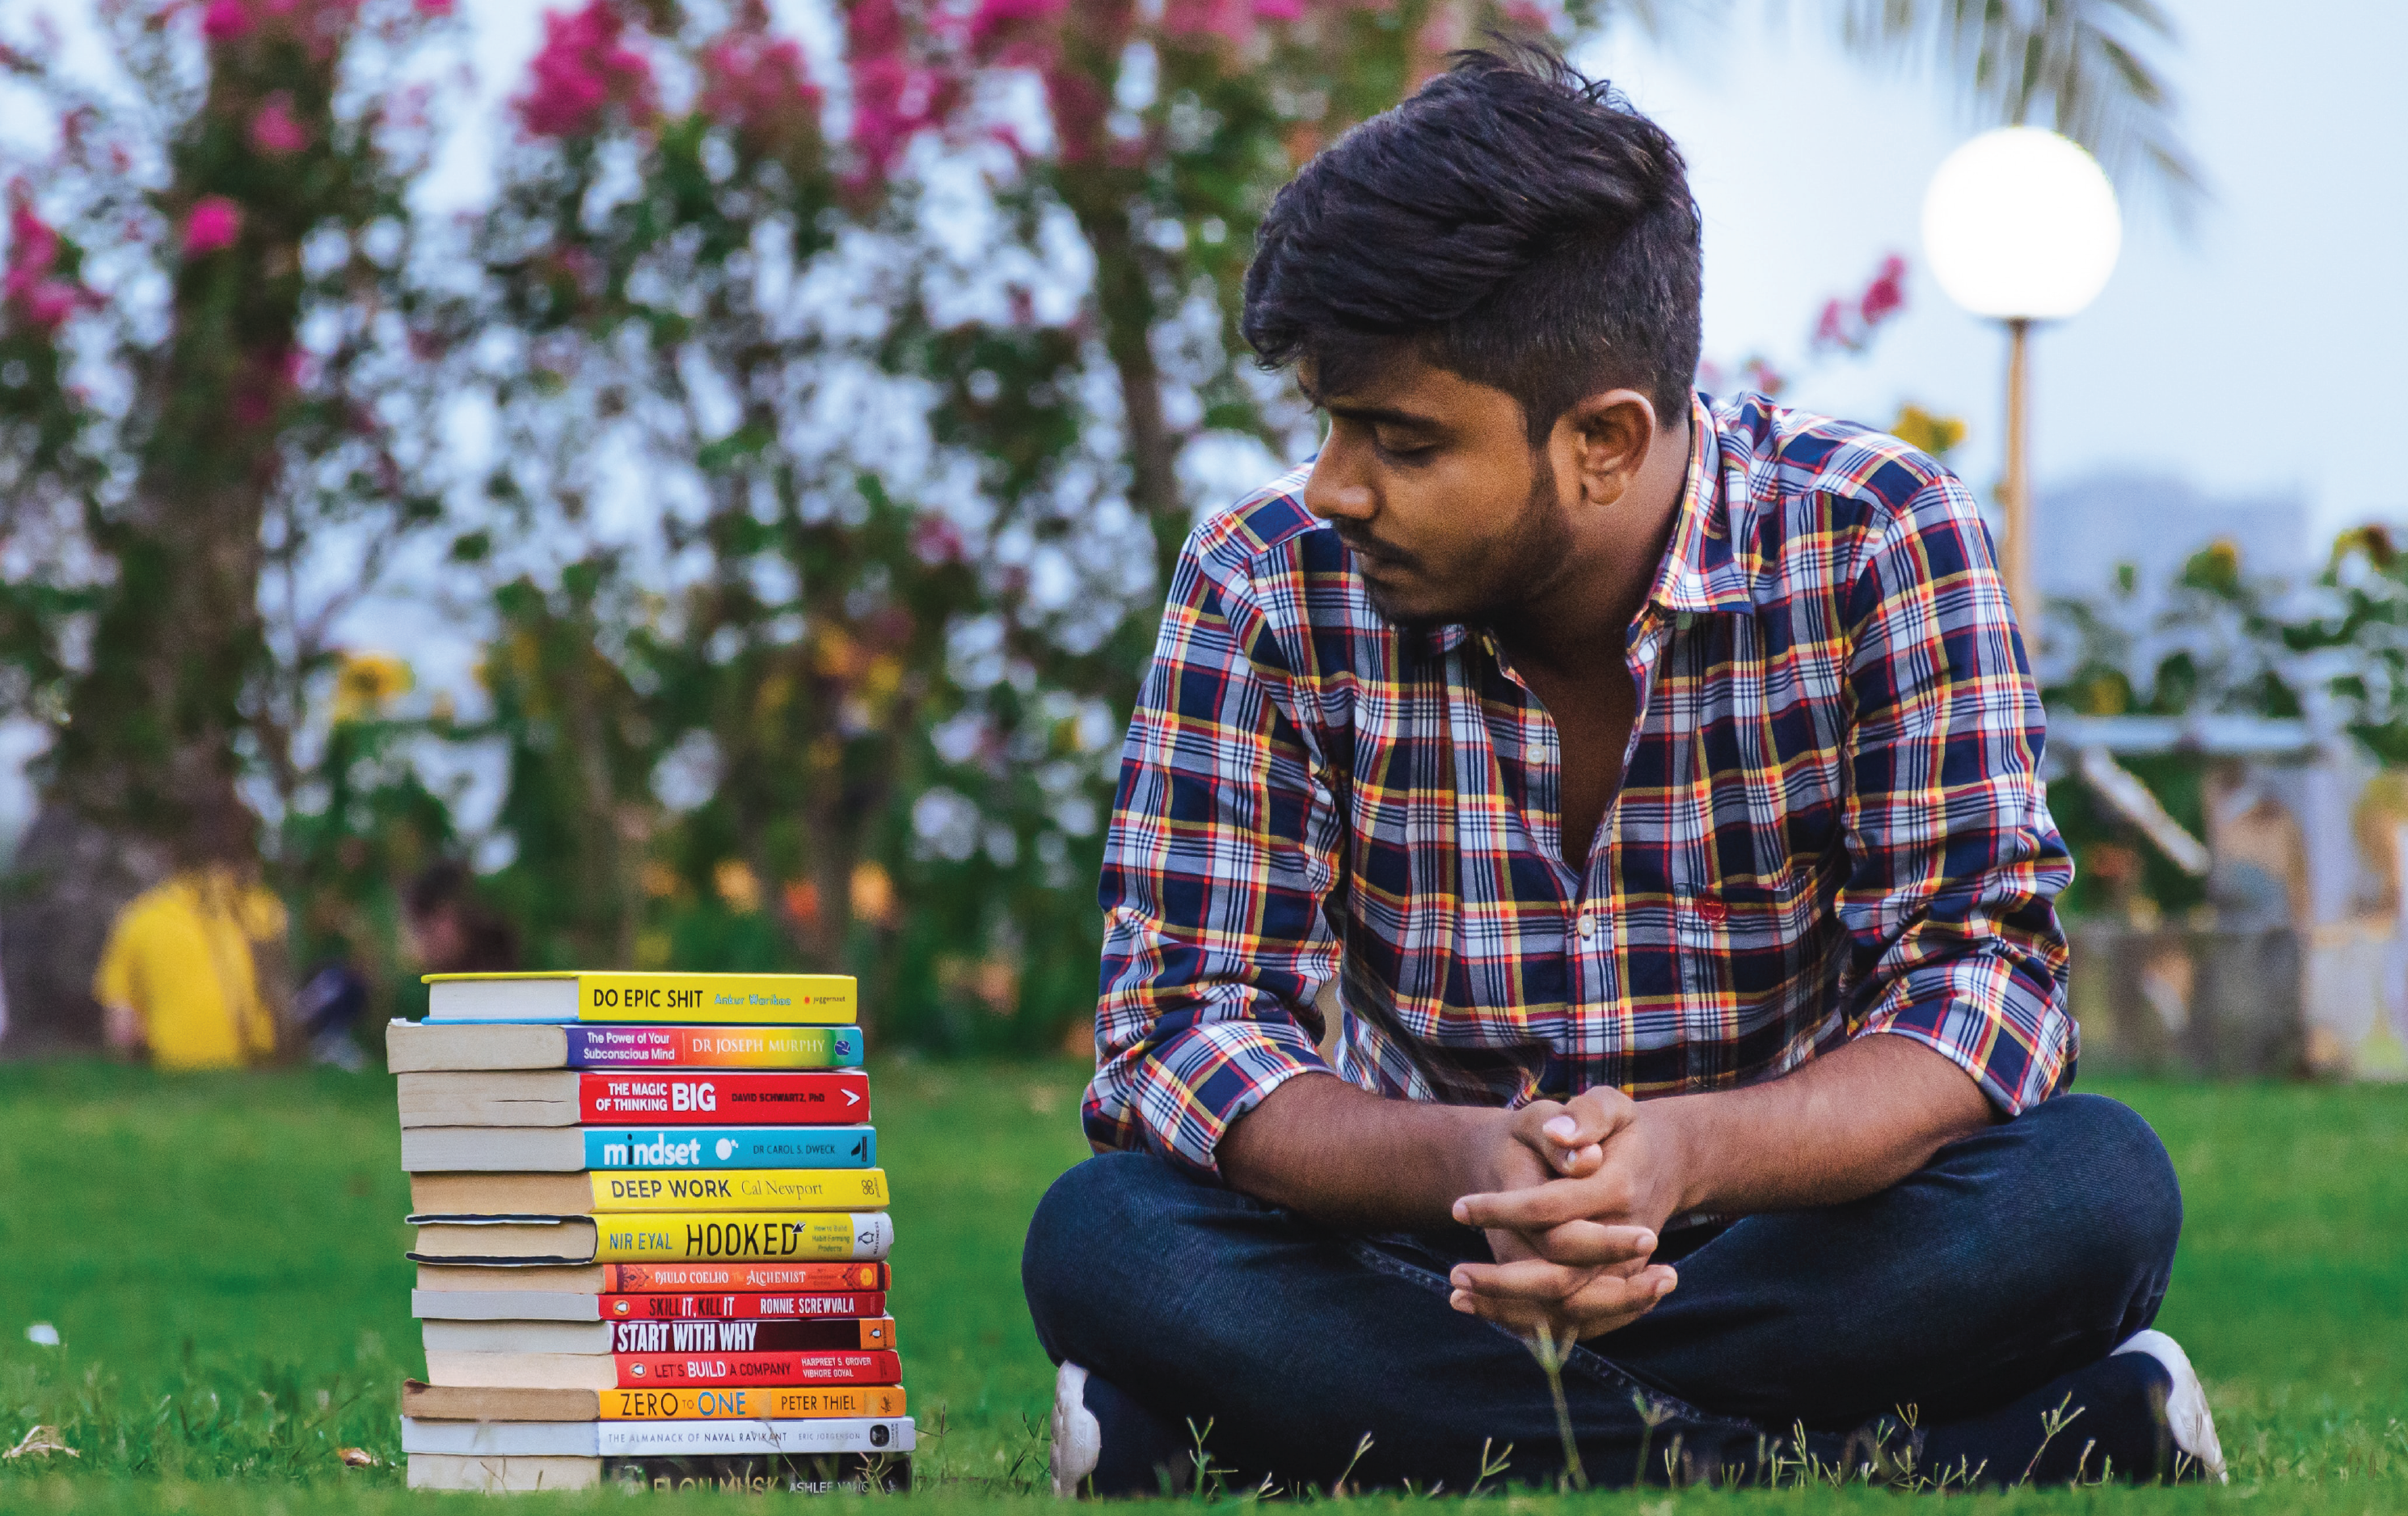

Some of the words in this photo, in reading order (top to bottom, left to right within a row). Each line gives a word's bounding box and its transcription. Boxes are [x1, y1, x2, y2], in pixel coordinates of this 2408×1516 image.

[594, 989, 618, 1007] DO
[625, 989, 661, 1007] EPIC
[668, 989, 703, 1008] SHIT
[715, 994, 744, 1005] Ankur
[749, 994, 791, 1006] Warikoo
[813, 995, 846, 1006] juggernaut
[588, 1032, 604, 1044] The
[606, 1032, 635, 1044] Power
[637, 1032, 647, 1044] of
[648, 1032, 669, 1045] Your
[584, 1047, 649, 1060] Subconscious
[651, 1048, 675, 1061] Mind
[693, 1039, 712, 1052] DR
[716, 1039, 764, 1054] JOSEPH
[769, 1039, 825, 1053] MURPHY
[608, 1083, 630, 1096] THE
[632, 1083, 668, 1096] MAGIC
[671, 1082, 716, 1112] BIG
[596, 1098, 612, 1111] OF
[614, 1098, 668, 1112] THINKING
[732, 1093, 757, 1102] DAVID
[759, 1093, 807, 1104] SCHWARTZ,
[809, 1093, 825, 1103] PhD
[604, 1133, 701, 1166] mindset
[753, 1145, 764, 1155] DR
[766, 1145, 795, 1155] CAROL
[797, 1145, 803, 1155] S.
[806, 1145, 835, 1155] DWECK
[611, 1180, 662, 1199] DEEP
[668, 1179, 732, 1199] WORK
[741, 1180, 762, 1197] Cal
[765, 1180, 824, 1201] Newport
[609, 1232, 633, 1251] NIR
[639, 1232, 673, 1251] EYAL
[685, 1223, 797, 1257] HOOKED
[655, 1271, 686, 1286] PAULO
[690, 1271, 729, 1284] COELHO
[746, 1269, 806, 1286] ALCHEMIST
[649, 1299, 681, 1316] SKILL
[698, 1298, 721, 1316] KILL
[723, 1296, 735, 1316] IT
[760, 1298, 795, 1315] RONNIE
[799, 1297, 855, 1314] SCREWVALA
[617, 1323, 669, 1353] START
[673, 1322, 715, 1352] WITH
[719, 1322, 757, 1352] WHY
[801, 1357, 836, 1366] HARPREET
[845, 1357, 872, 1366] GROVER
[654, 1364, 685, 1379] LET'S
[687, 1361, 726, 1379] BUILD
[729, 1364, 737, 1376] A
[739, 1362, 791, 1376] COMPANY
[803, 1369, 832, 1379] VIBHORE
[833, 1369, 854, 1378] GOYAL
[620, 1391, 678, 1417] ZERO
[682, 1399, 694, 1410] TO
[698, 1391, 746, 1417] ONE
[781, 1396, 817, 1411] PETER
[823, 1396, 856, 1410] THIEL
[608, 1434, 625, 1443] THE
[629, 1433, 684, 1443] ALMANACK
[688, 1433, 700, 1442] OF
[704, 1433, 736, 1442] NAVAL
[739, 1432, 787, 1442] RAVIKANT
[799, 1433, 813, 1442] ERIC
[816, 1433, 861, 1441] JORGENSON
